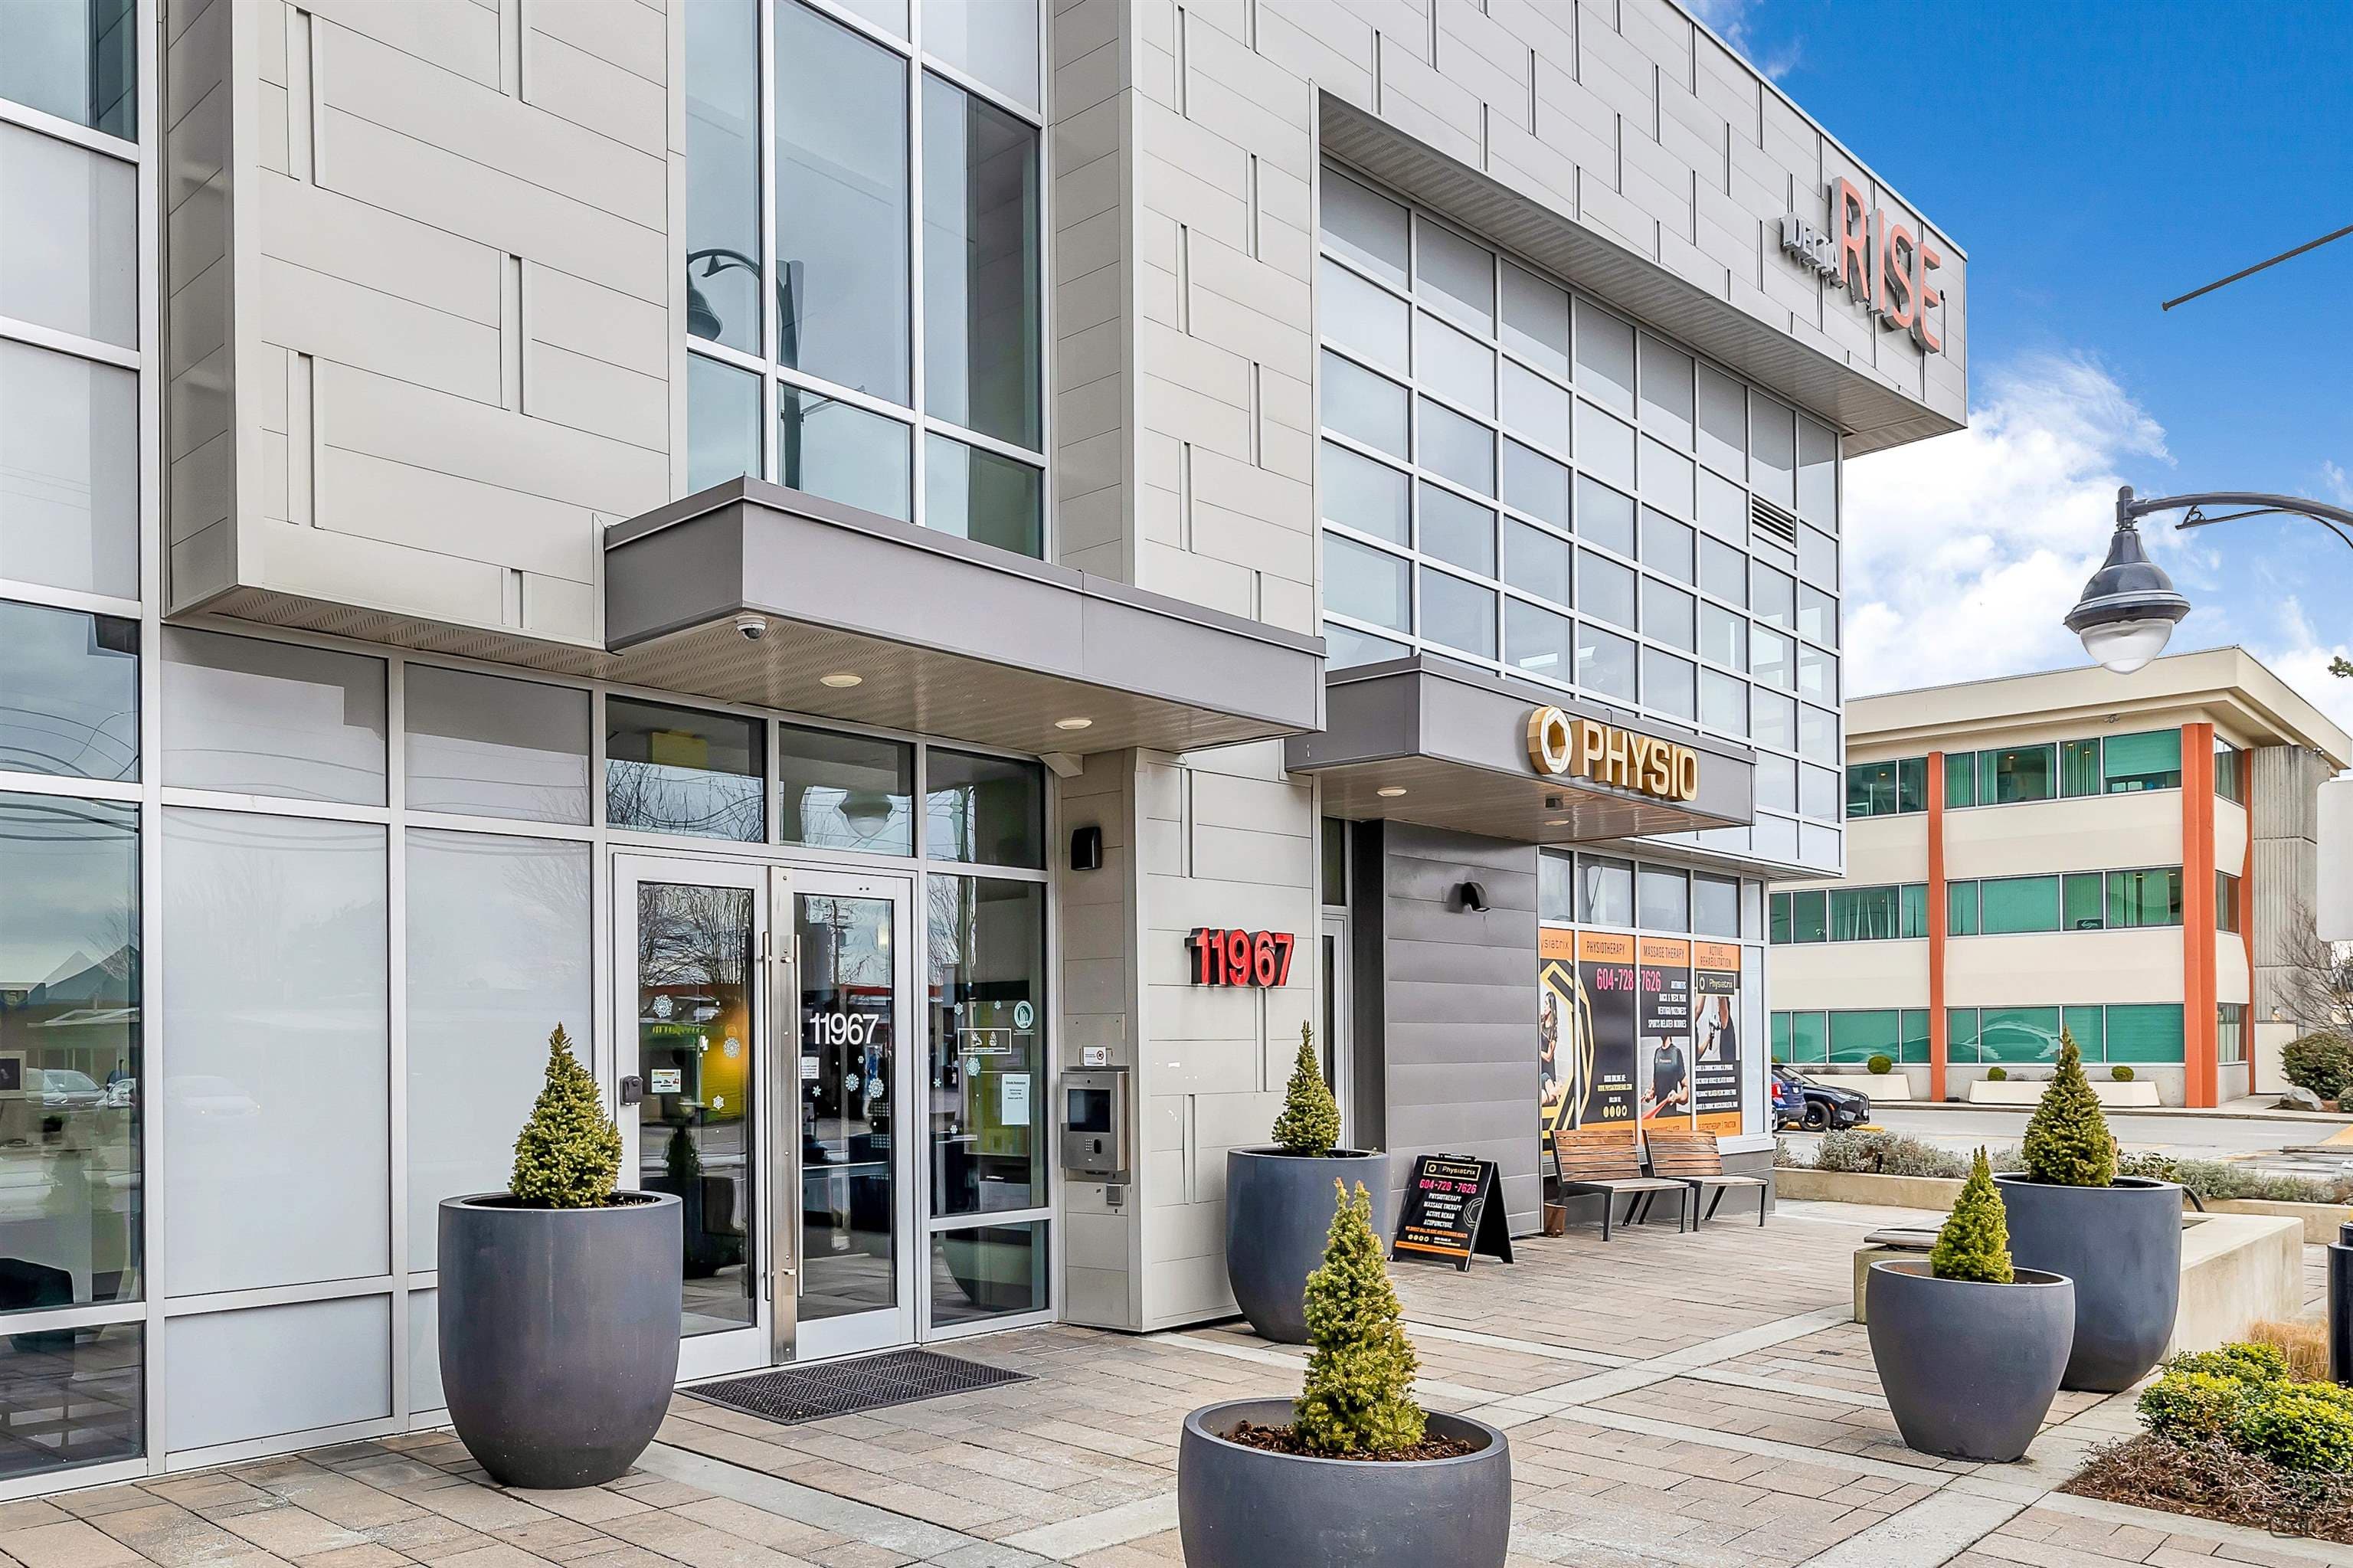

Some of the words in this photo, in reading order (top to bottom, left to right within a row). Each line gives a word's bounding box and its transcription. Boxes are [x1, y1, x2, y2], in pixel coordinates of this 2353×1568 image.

[1834, 176, 1941, 354] RISE
[1576, 719, 1698, 801] PHYSIO
[1185, 928, 1294, 987] 11967
[1586, 941, 1625, 955] PHYSIOTHERAPY
[1643, 945, 1664, 959] MASSAGE
[1665, 947, 1684, 960] THERAPY
[1596, 967, 1634, 991] 604-728
[810, 1012, 879, 1045] 11967
[1442, 1166, 1475, 1174] Physiatrix
[1419, 1179, 1451, 1191] 604-728
[1455, 1182, 1478, 1194] -7626
